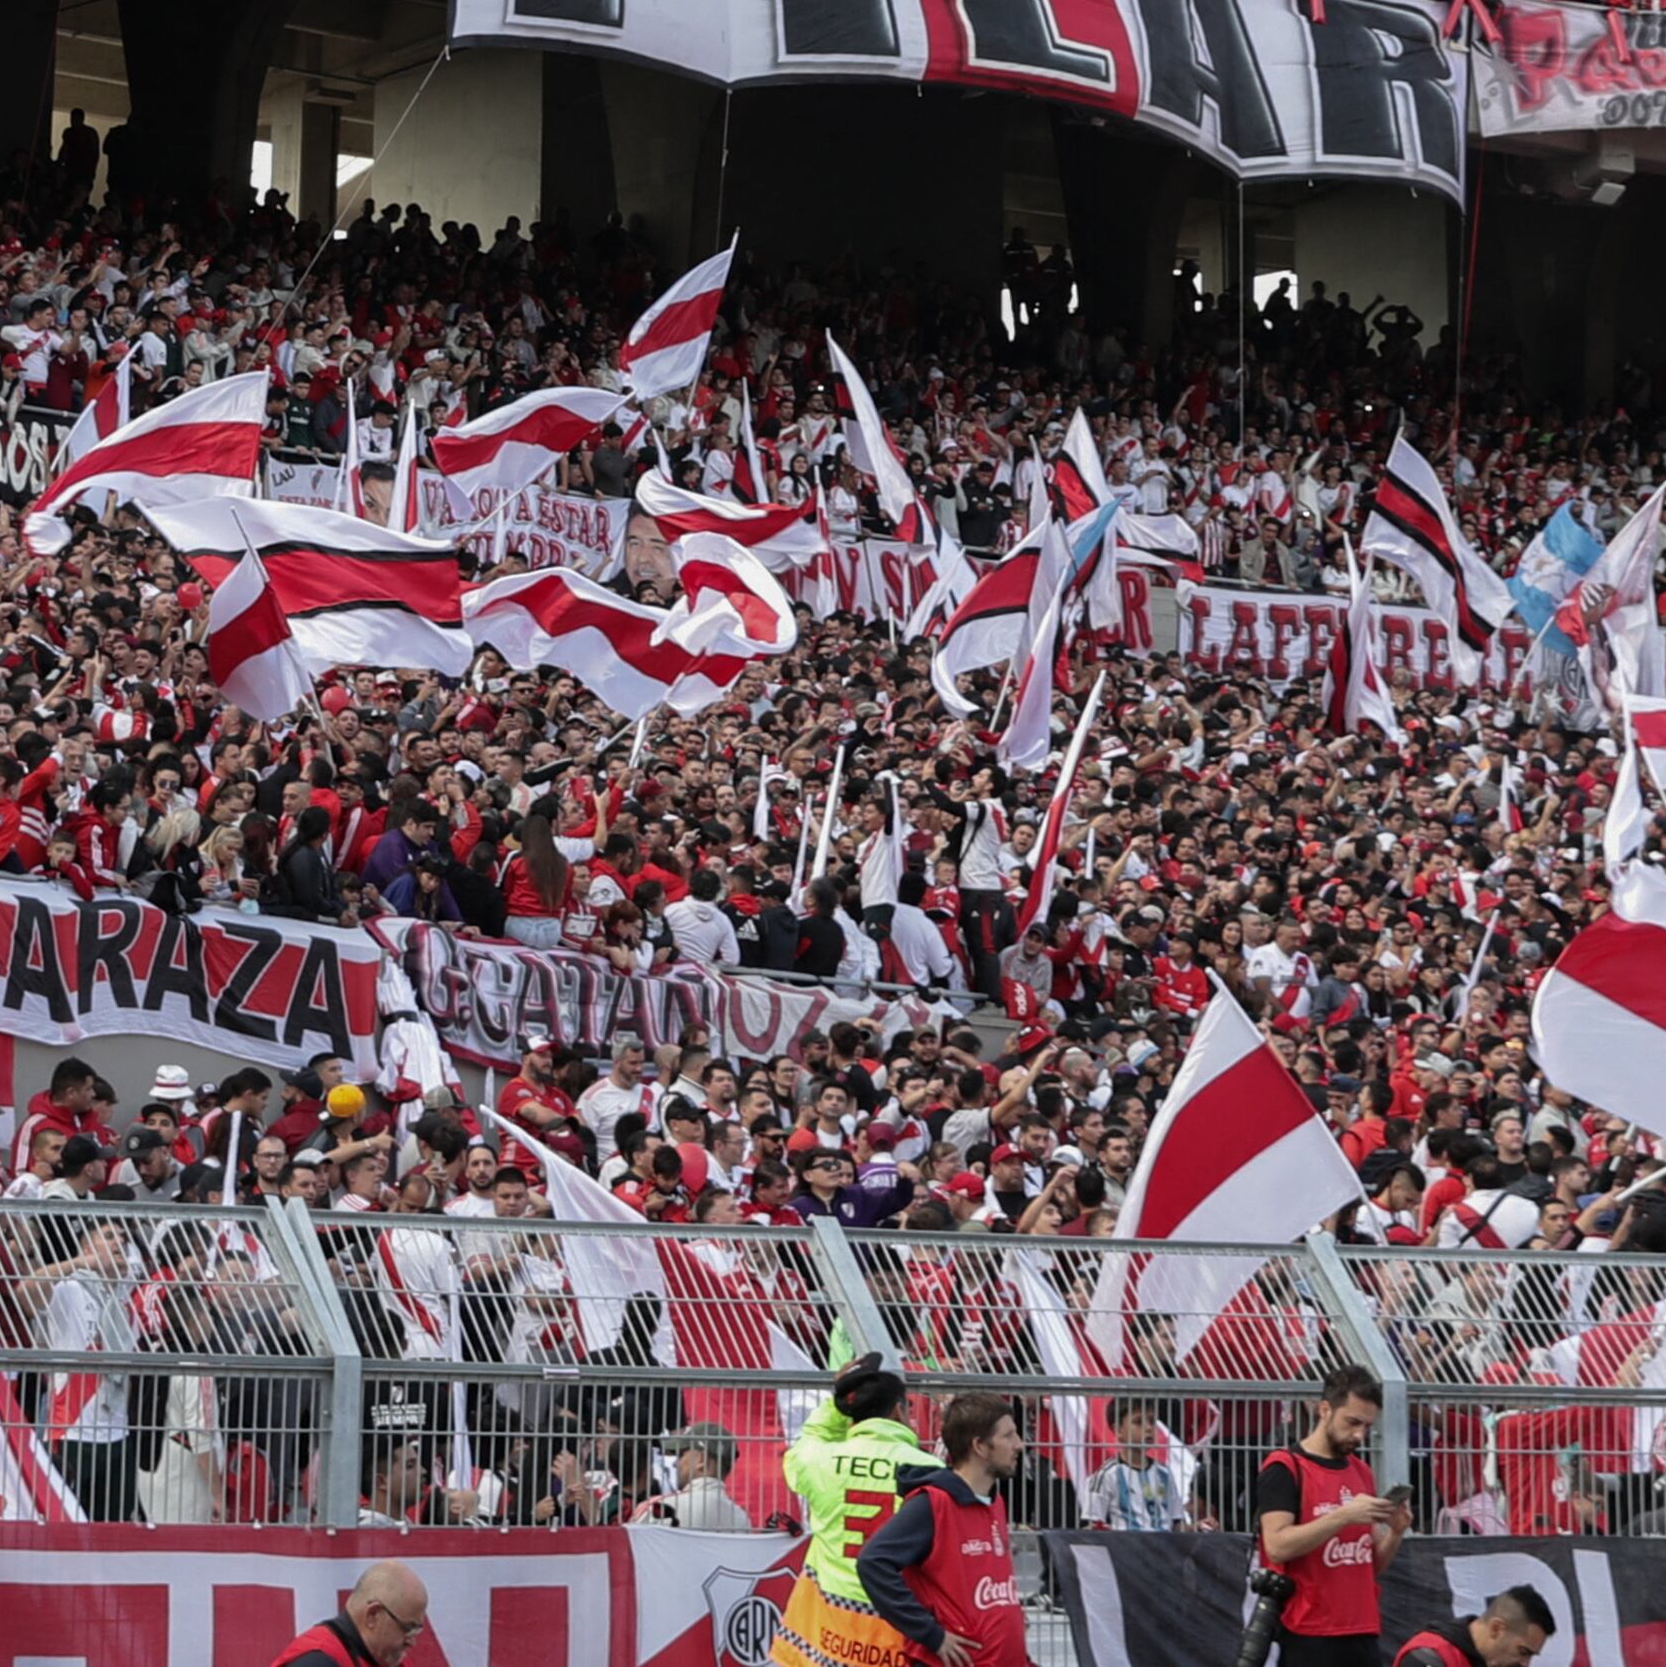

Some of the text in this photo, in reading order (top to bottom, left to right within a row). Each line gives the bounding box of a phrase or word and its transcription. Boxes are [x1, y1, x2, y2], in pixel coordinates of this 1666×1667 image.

[536, 493, 612, 553] ESTAR
[1184, 595, 1533, 703] LAFEREE
[831, 1454, 899, 1481] TEC
